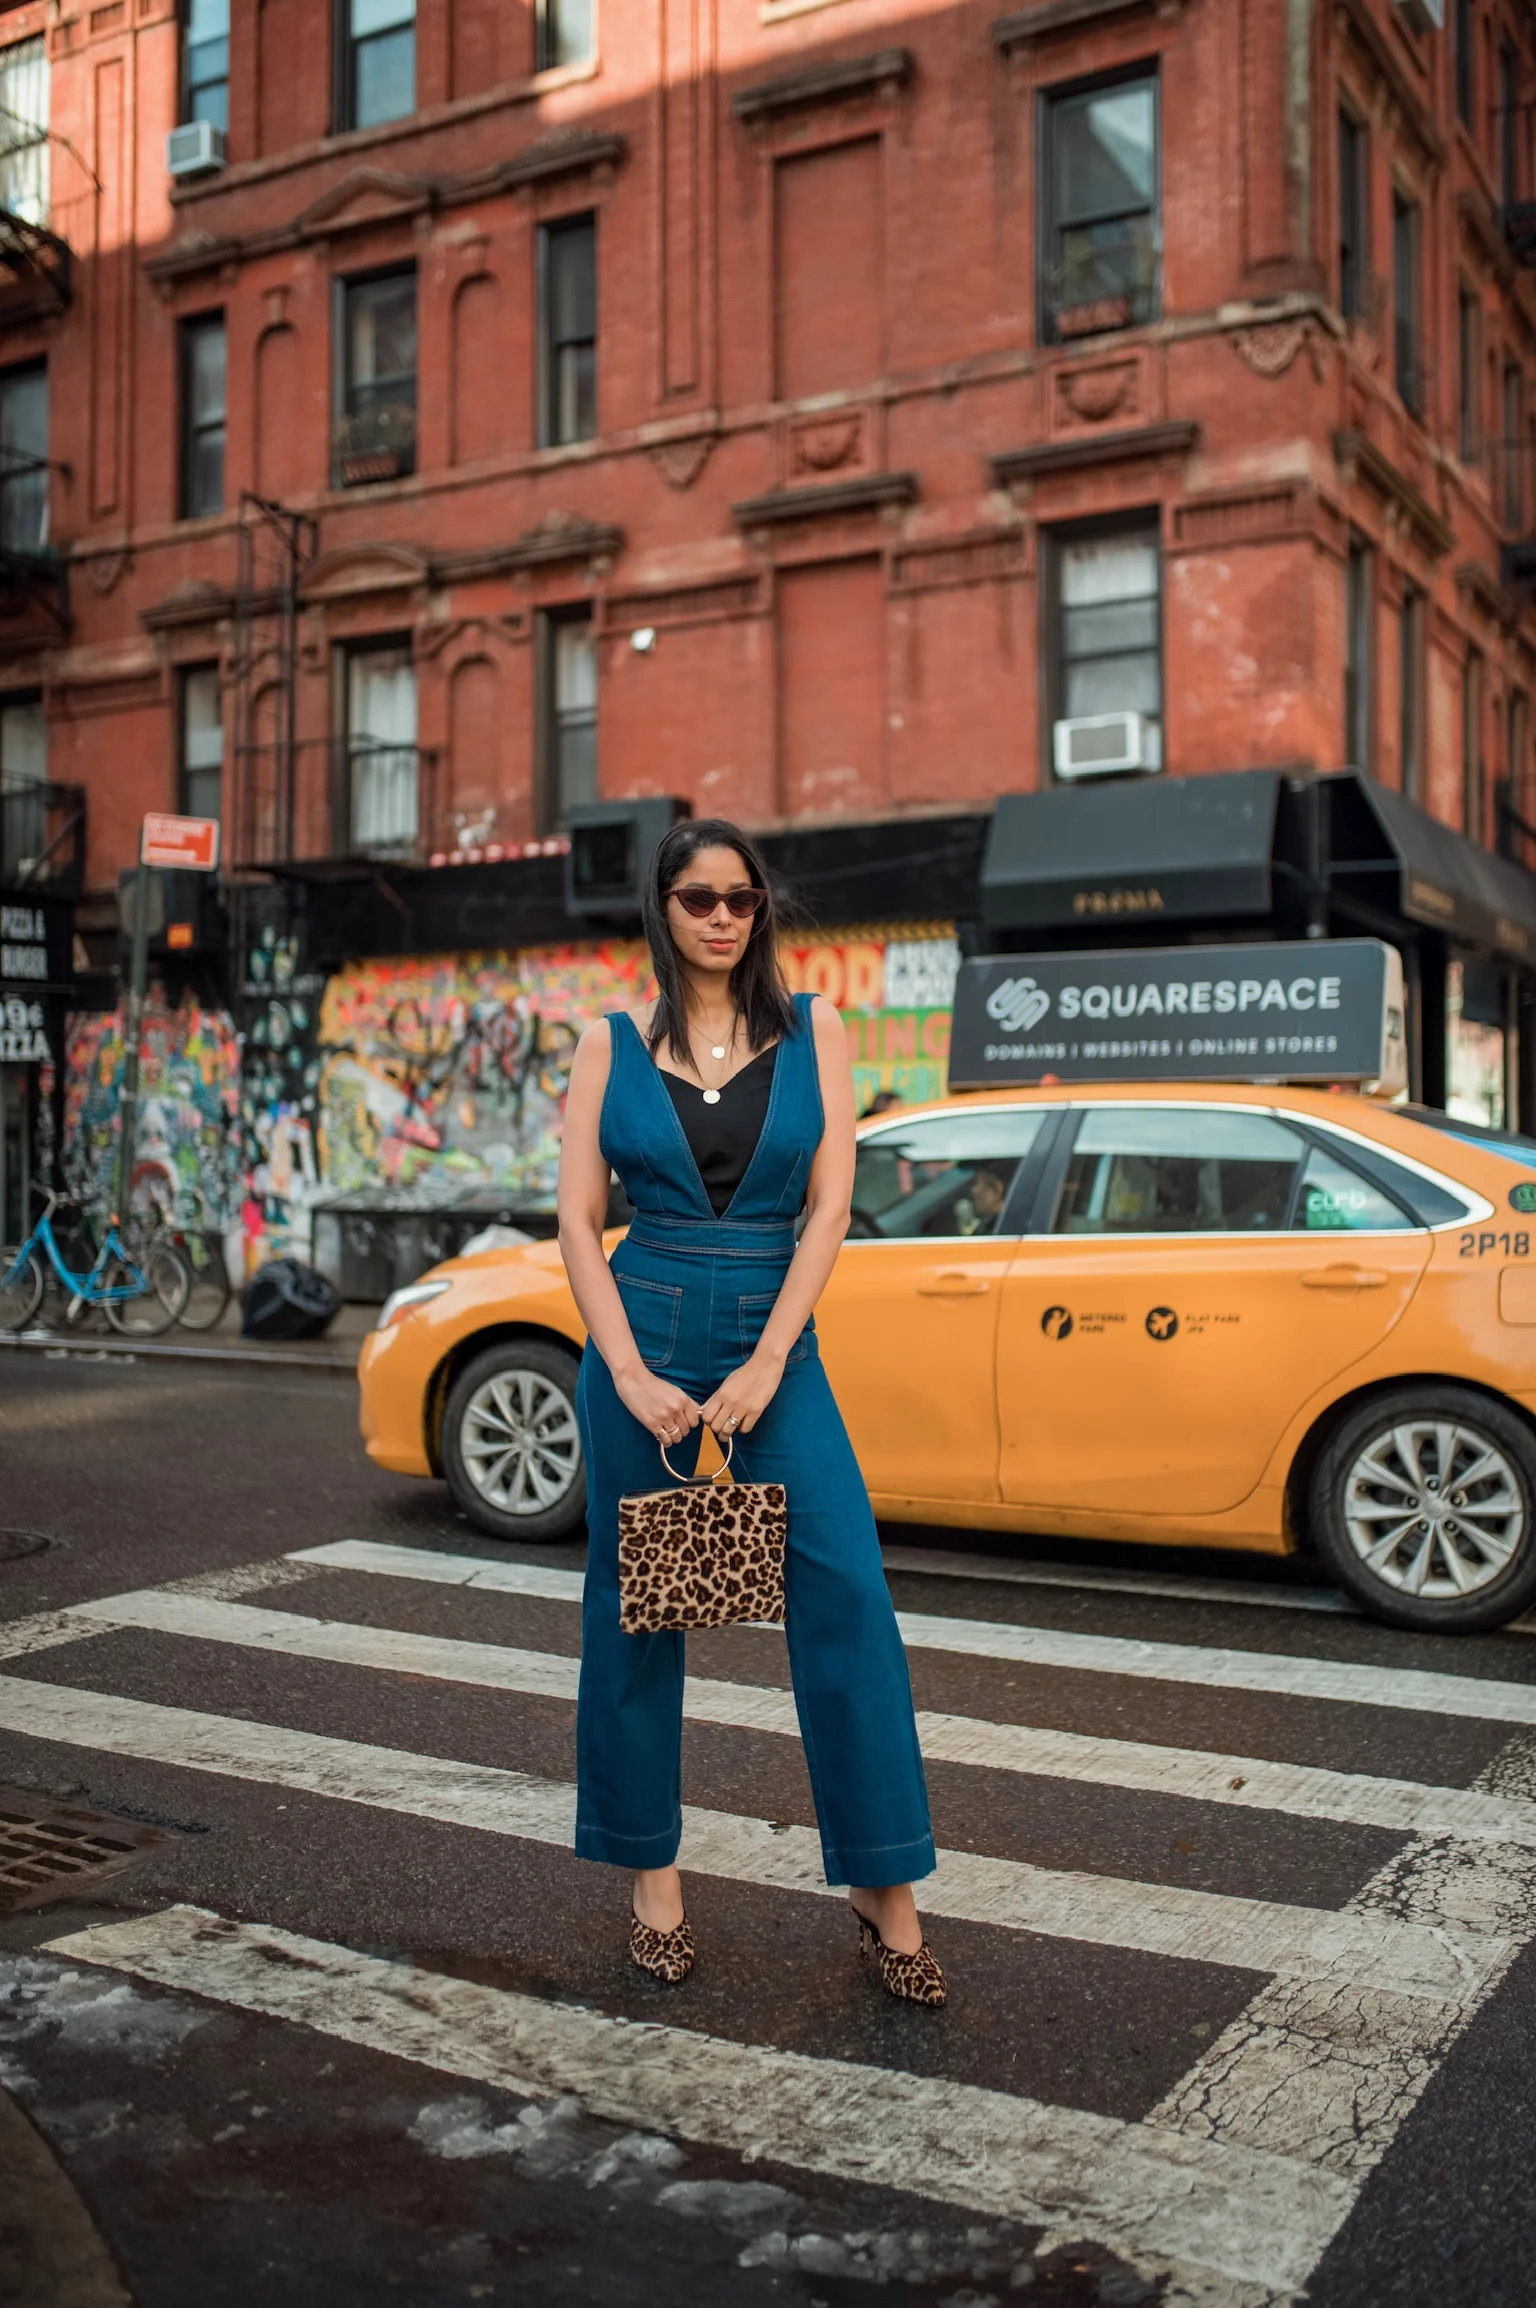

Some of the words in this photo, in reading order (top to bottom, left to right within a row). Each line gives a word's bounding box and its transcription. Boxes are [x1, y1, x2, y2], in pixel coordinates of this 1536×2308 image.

[1, 944, 48, 980] BURGER
[0, 998, 44, 1030] 9¢
[1058, 976, 1342, 1020] SQUARESPACE
[984, 1043, 1067, 1061] DOMAINS
[1082, 1039, 1171, 1058] WEBSITES
[1188, 1037, 1259, 1056] ONLINE
[1265, 1035, 1338, 1054] STORES
[1459, 1233, 1530, 1257] 2P18
